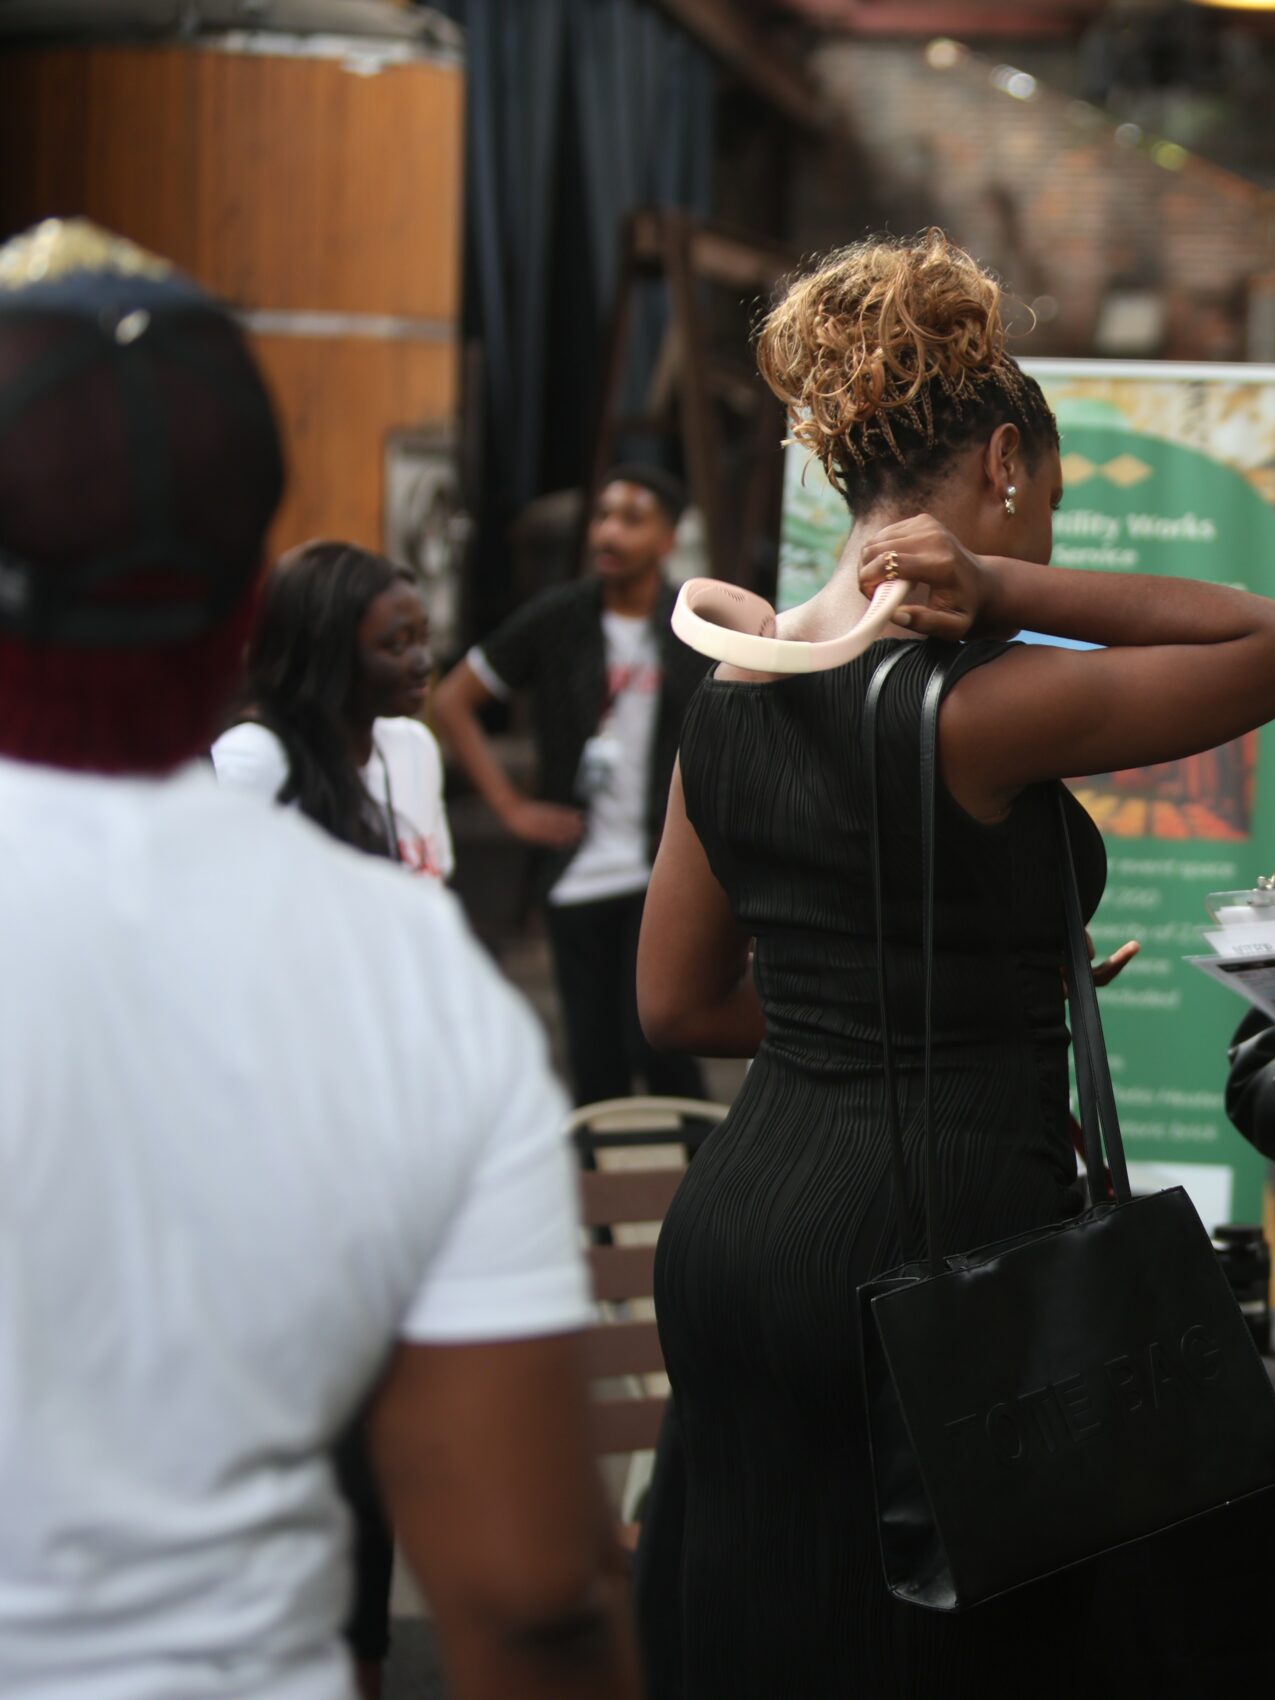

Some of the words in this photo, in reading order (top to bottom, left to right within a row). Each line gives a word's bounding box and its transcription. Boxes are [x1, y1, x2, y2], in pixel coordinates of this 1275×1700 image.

[1126, 514, 1217, 543] Works
[943, 1372, 1102, 1467] TOTE
[1103, 1322, 1226, 1424] BAG
